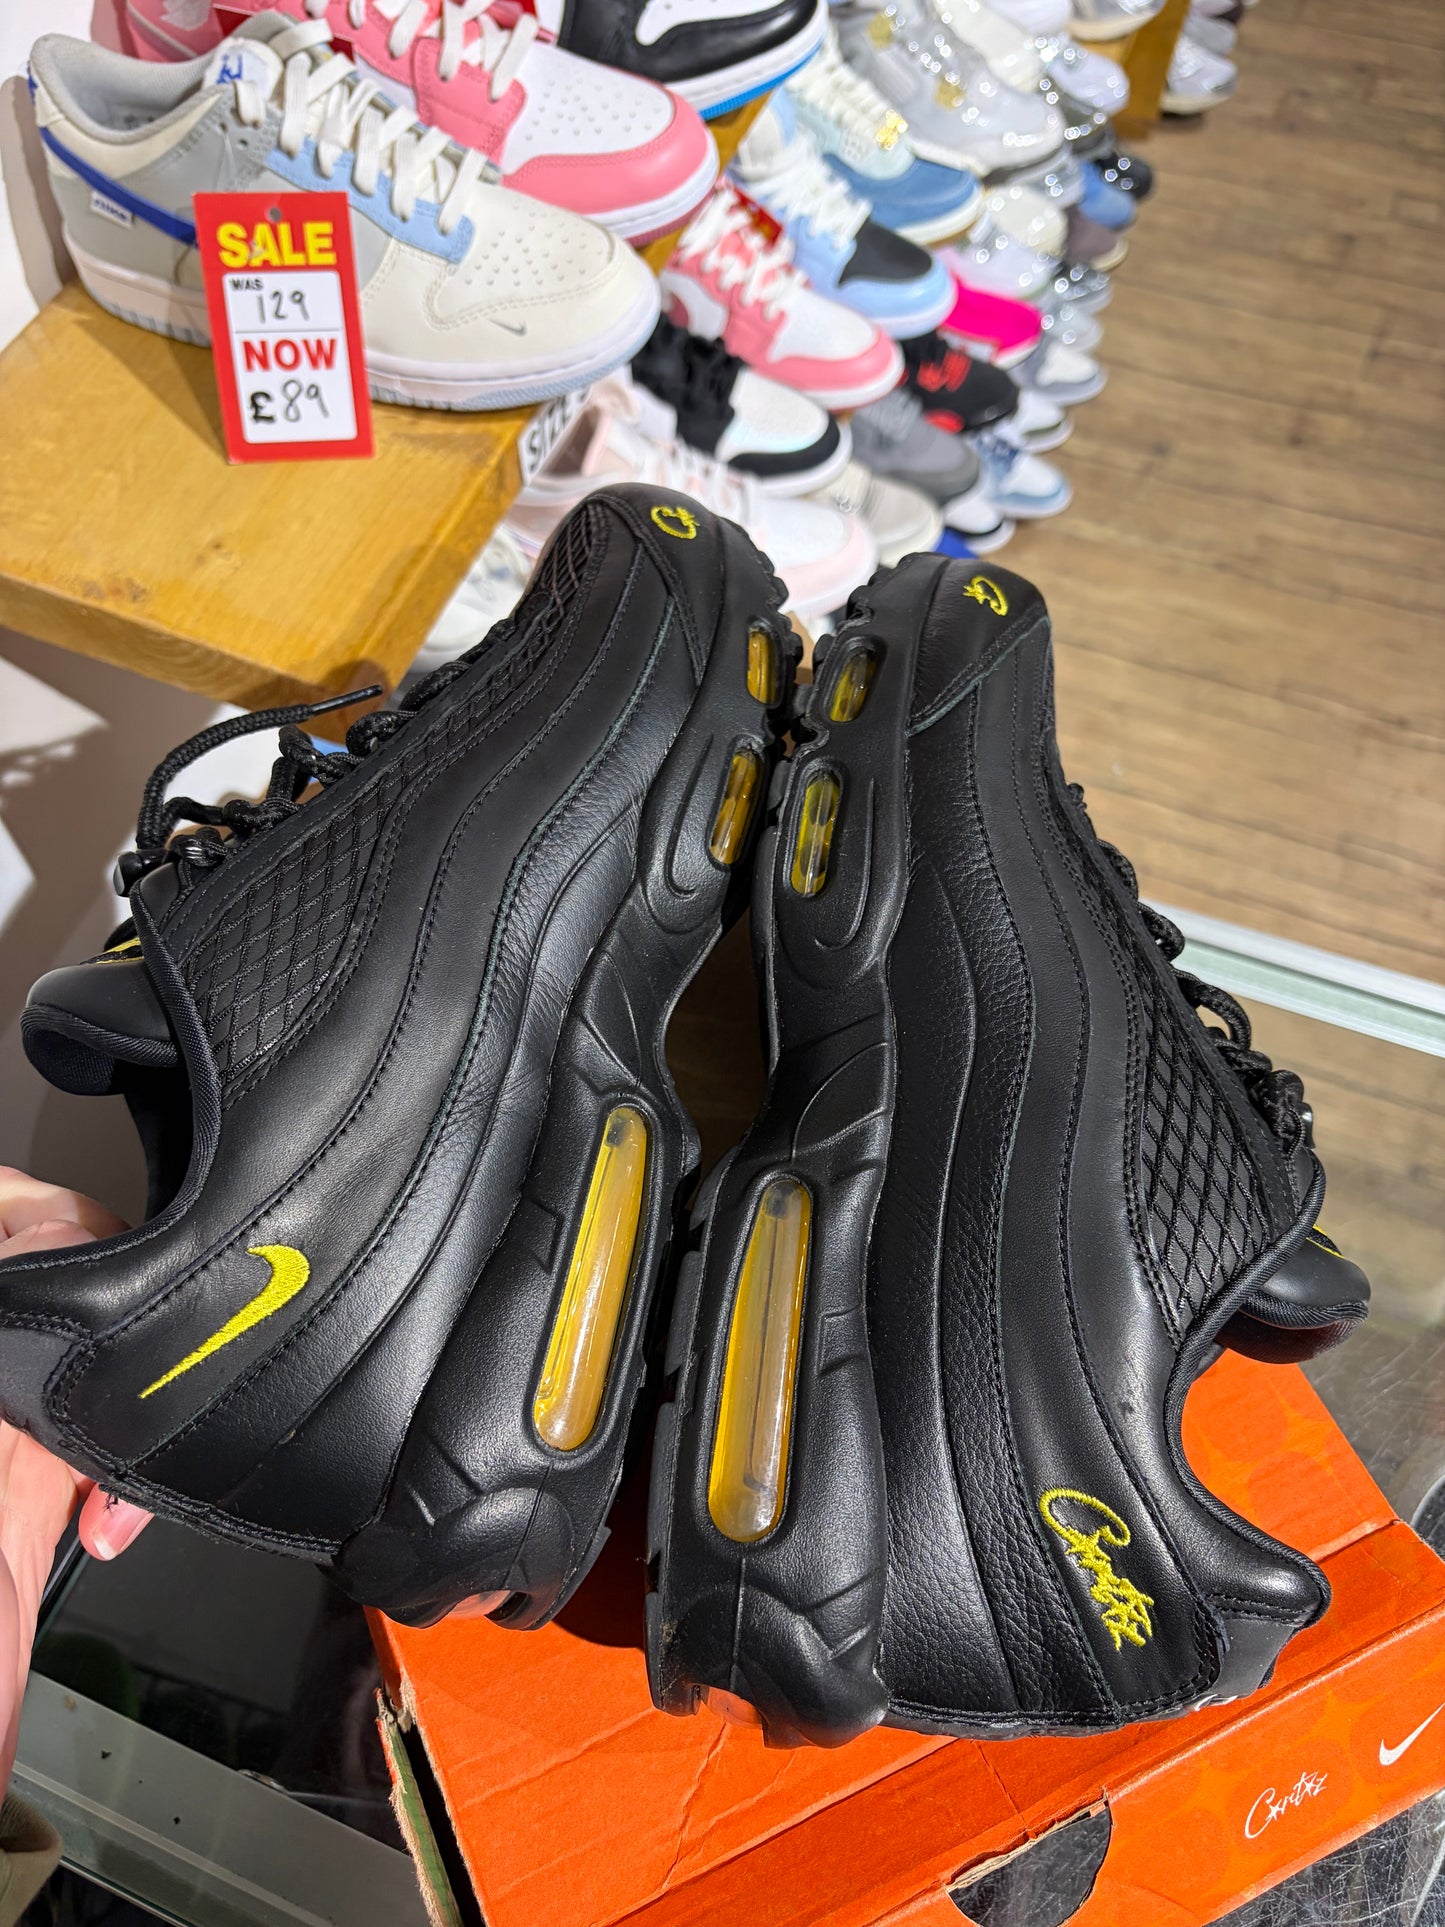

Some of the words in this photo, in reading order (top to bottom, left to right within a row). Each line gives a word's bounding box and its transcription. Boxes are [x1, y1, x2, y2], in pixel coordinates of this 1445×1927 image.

[217, 222, 337, 267] SALE
[230, 279, 264, 291] WAS
[256, 290, 309, 323] 129
[242, 338, 336, 371] NOW
[250, 379, 329, 423] £89
